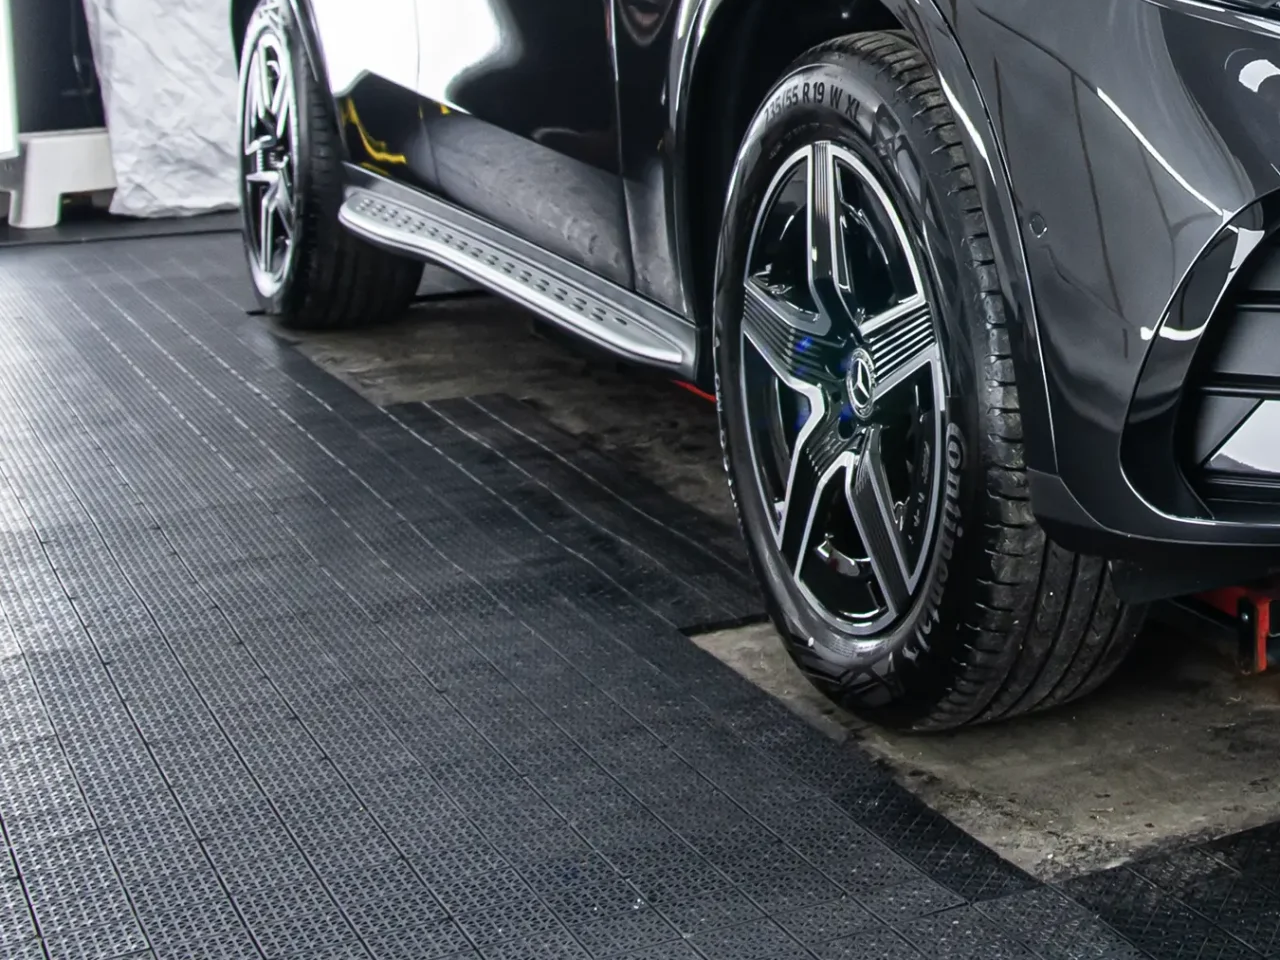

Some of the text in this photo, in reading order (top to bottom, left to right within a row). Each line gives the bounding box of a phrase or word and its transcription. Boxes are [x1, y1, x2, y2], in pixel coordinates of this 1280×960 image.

[764, 85, 799, 123] 235/55
[812, 81, 825, 104] 19
[830, 84, 843, 110] W
[845, 94, 860, 123] XL
